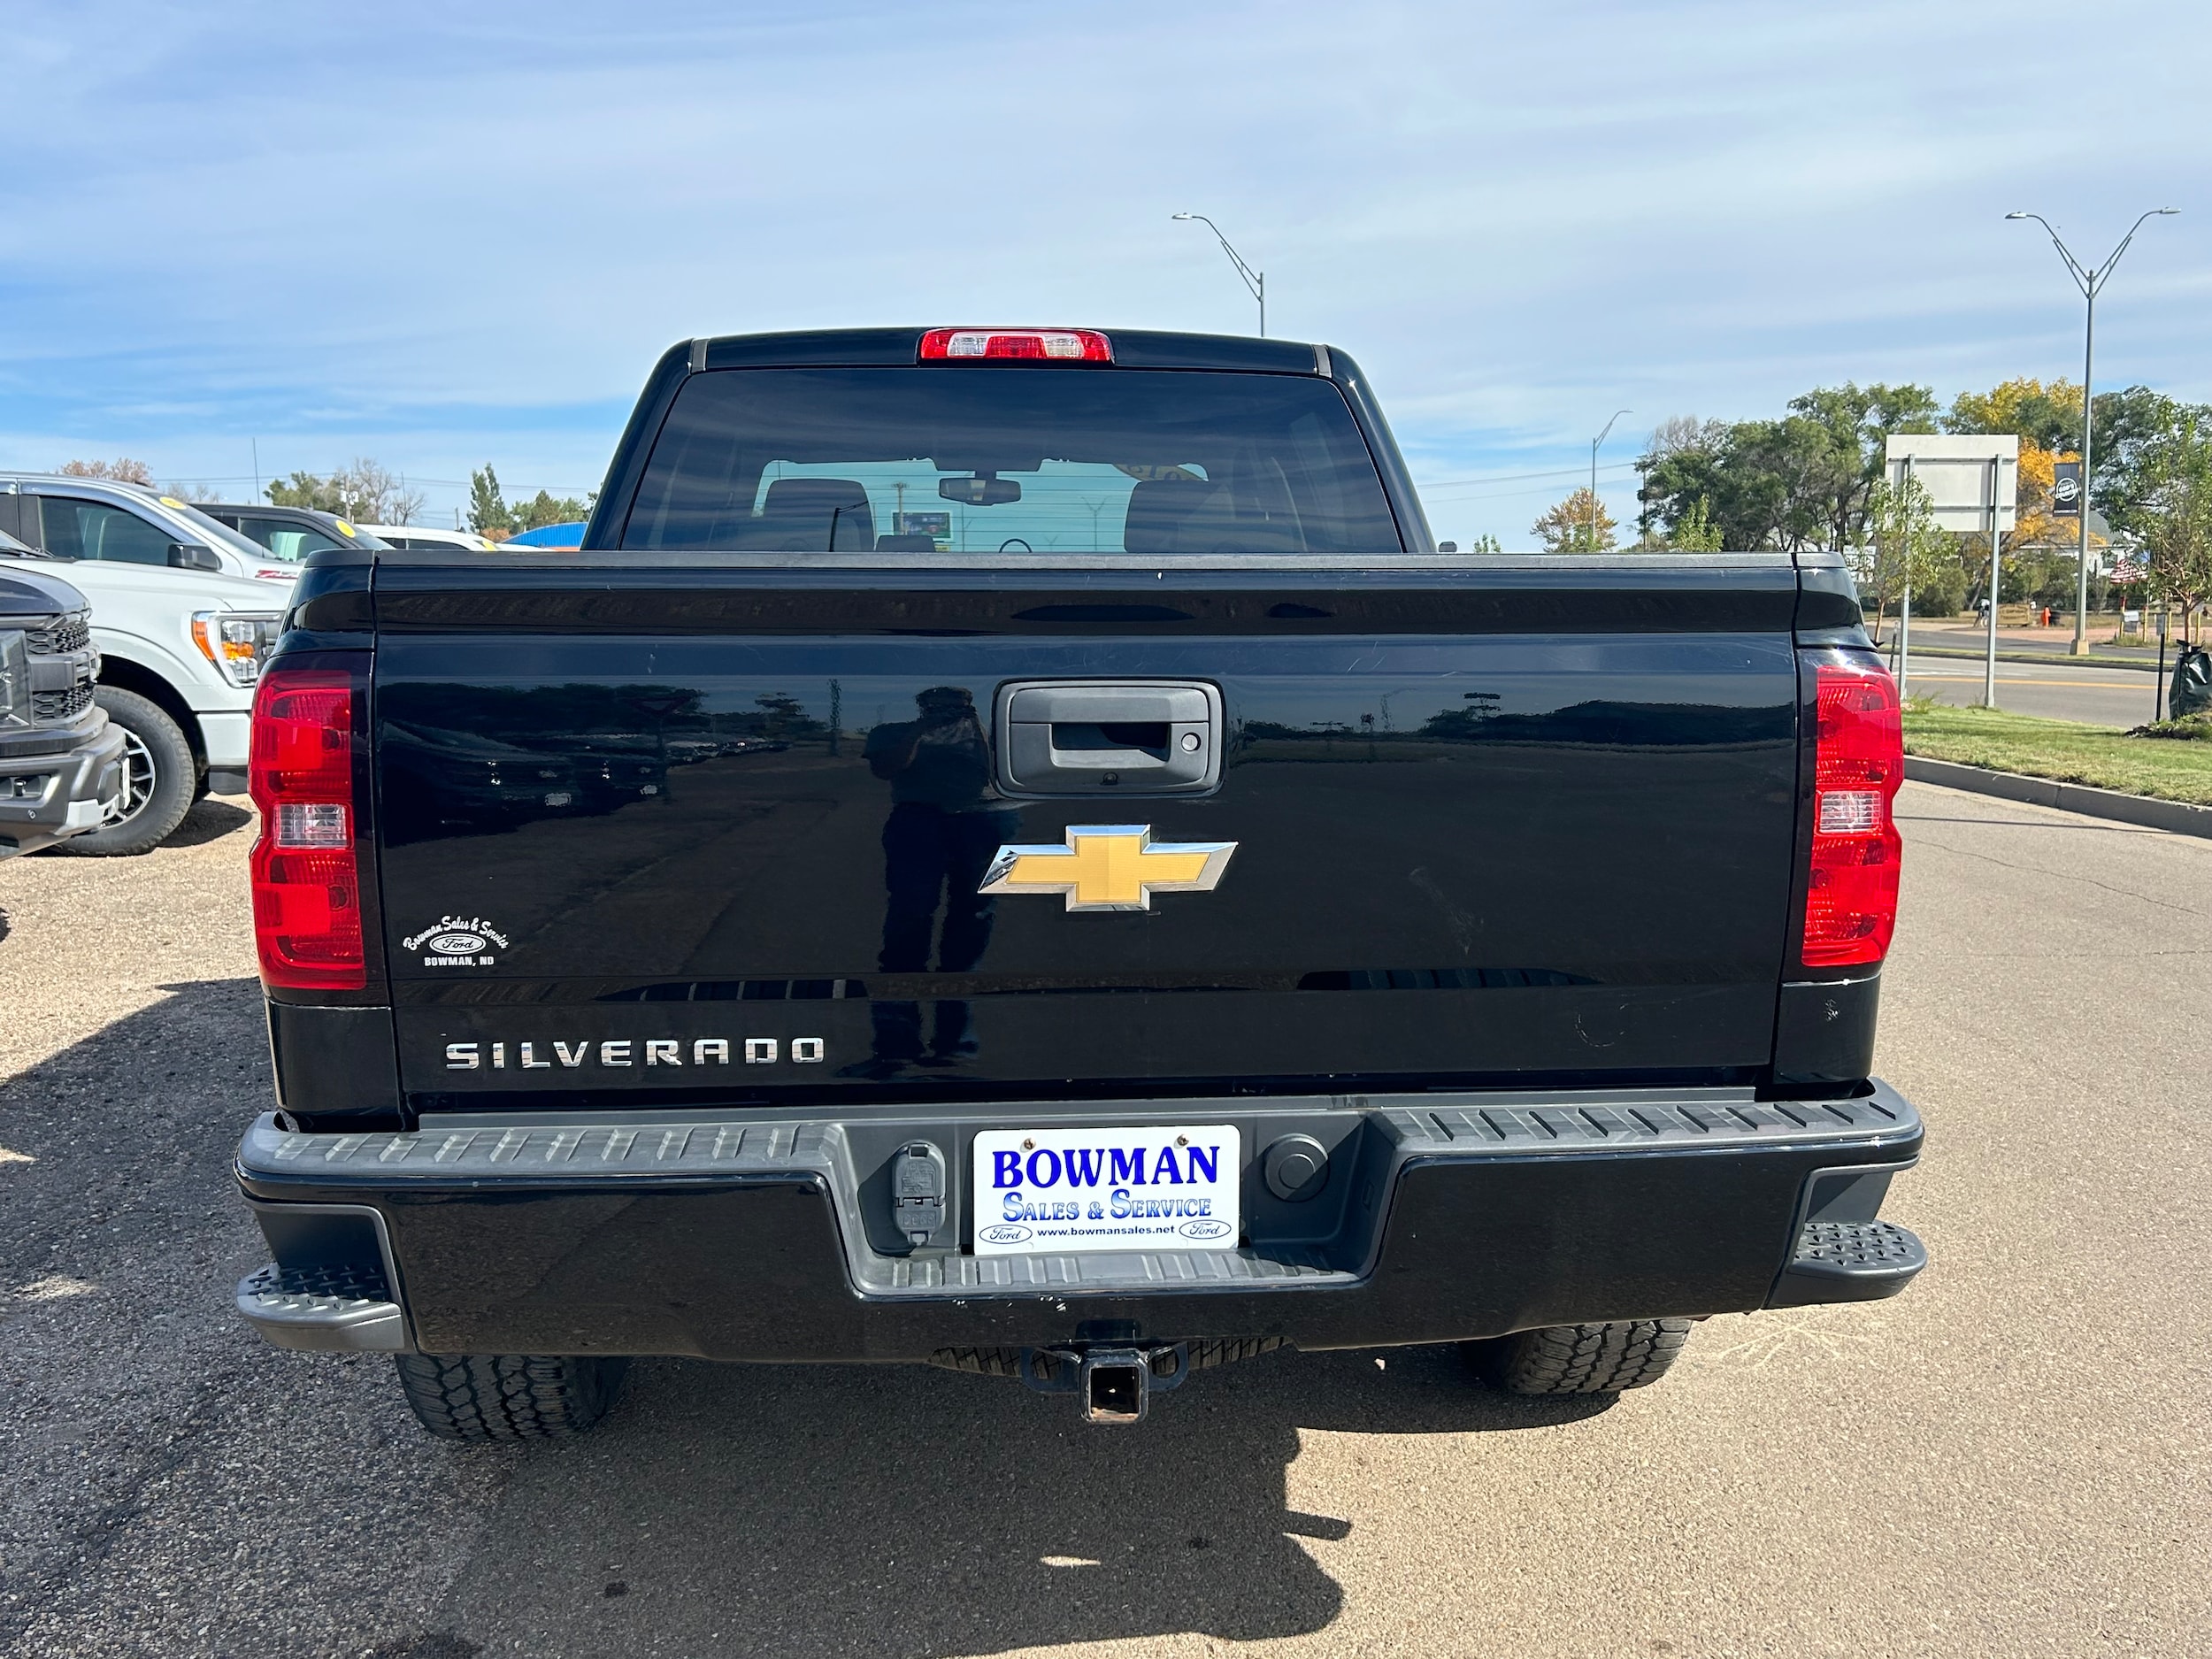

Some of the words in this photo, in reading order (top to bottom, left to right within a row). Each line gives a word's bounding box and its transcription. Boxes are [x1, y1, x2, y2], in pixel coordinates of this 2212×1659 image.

[403, 924, 443, 951] Bowman
[442, 916, 470, 931] Sales
[470, 917, 480, 931] &
[479, 921, 510, 949] Service
[442, 938, 473, 949] Ford
[424, 956, 476, 966] BOWMAN,
[479, 956, 495, 965] ND
[445, 1037, 825, 1070] SILVERADO
[992, 1146, 1220, 1188] BOWMAN
[1002, 1191, 1079, 1222] SALES
[1087, 1202, 1105, 1220] &
[1110, 1188, 1211, 1219] SERVICE
[988, 1226, 1022, 1240] Ford
[1037, 1225, 1175, 1237] www.bowmansales.net
[1189, 1223, 1220, 1236] Ford
